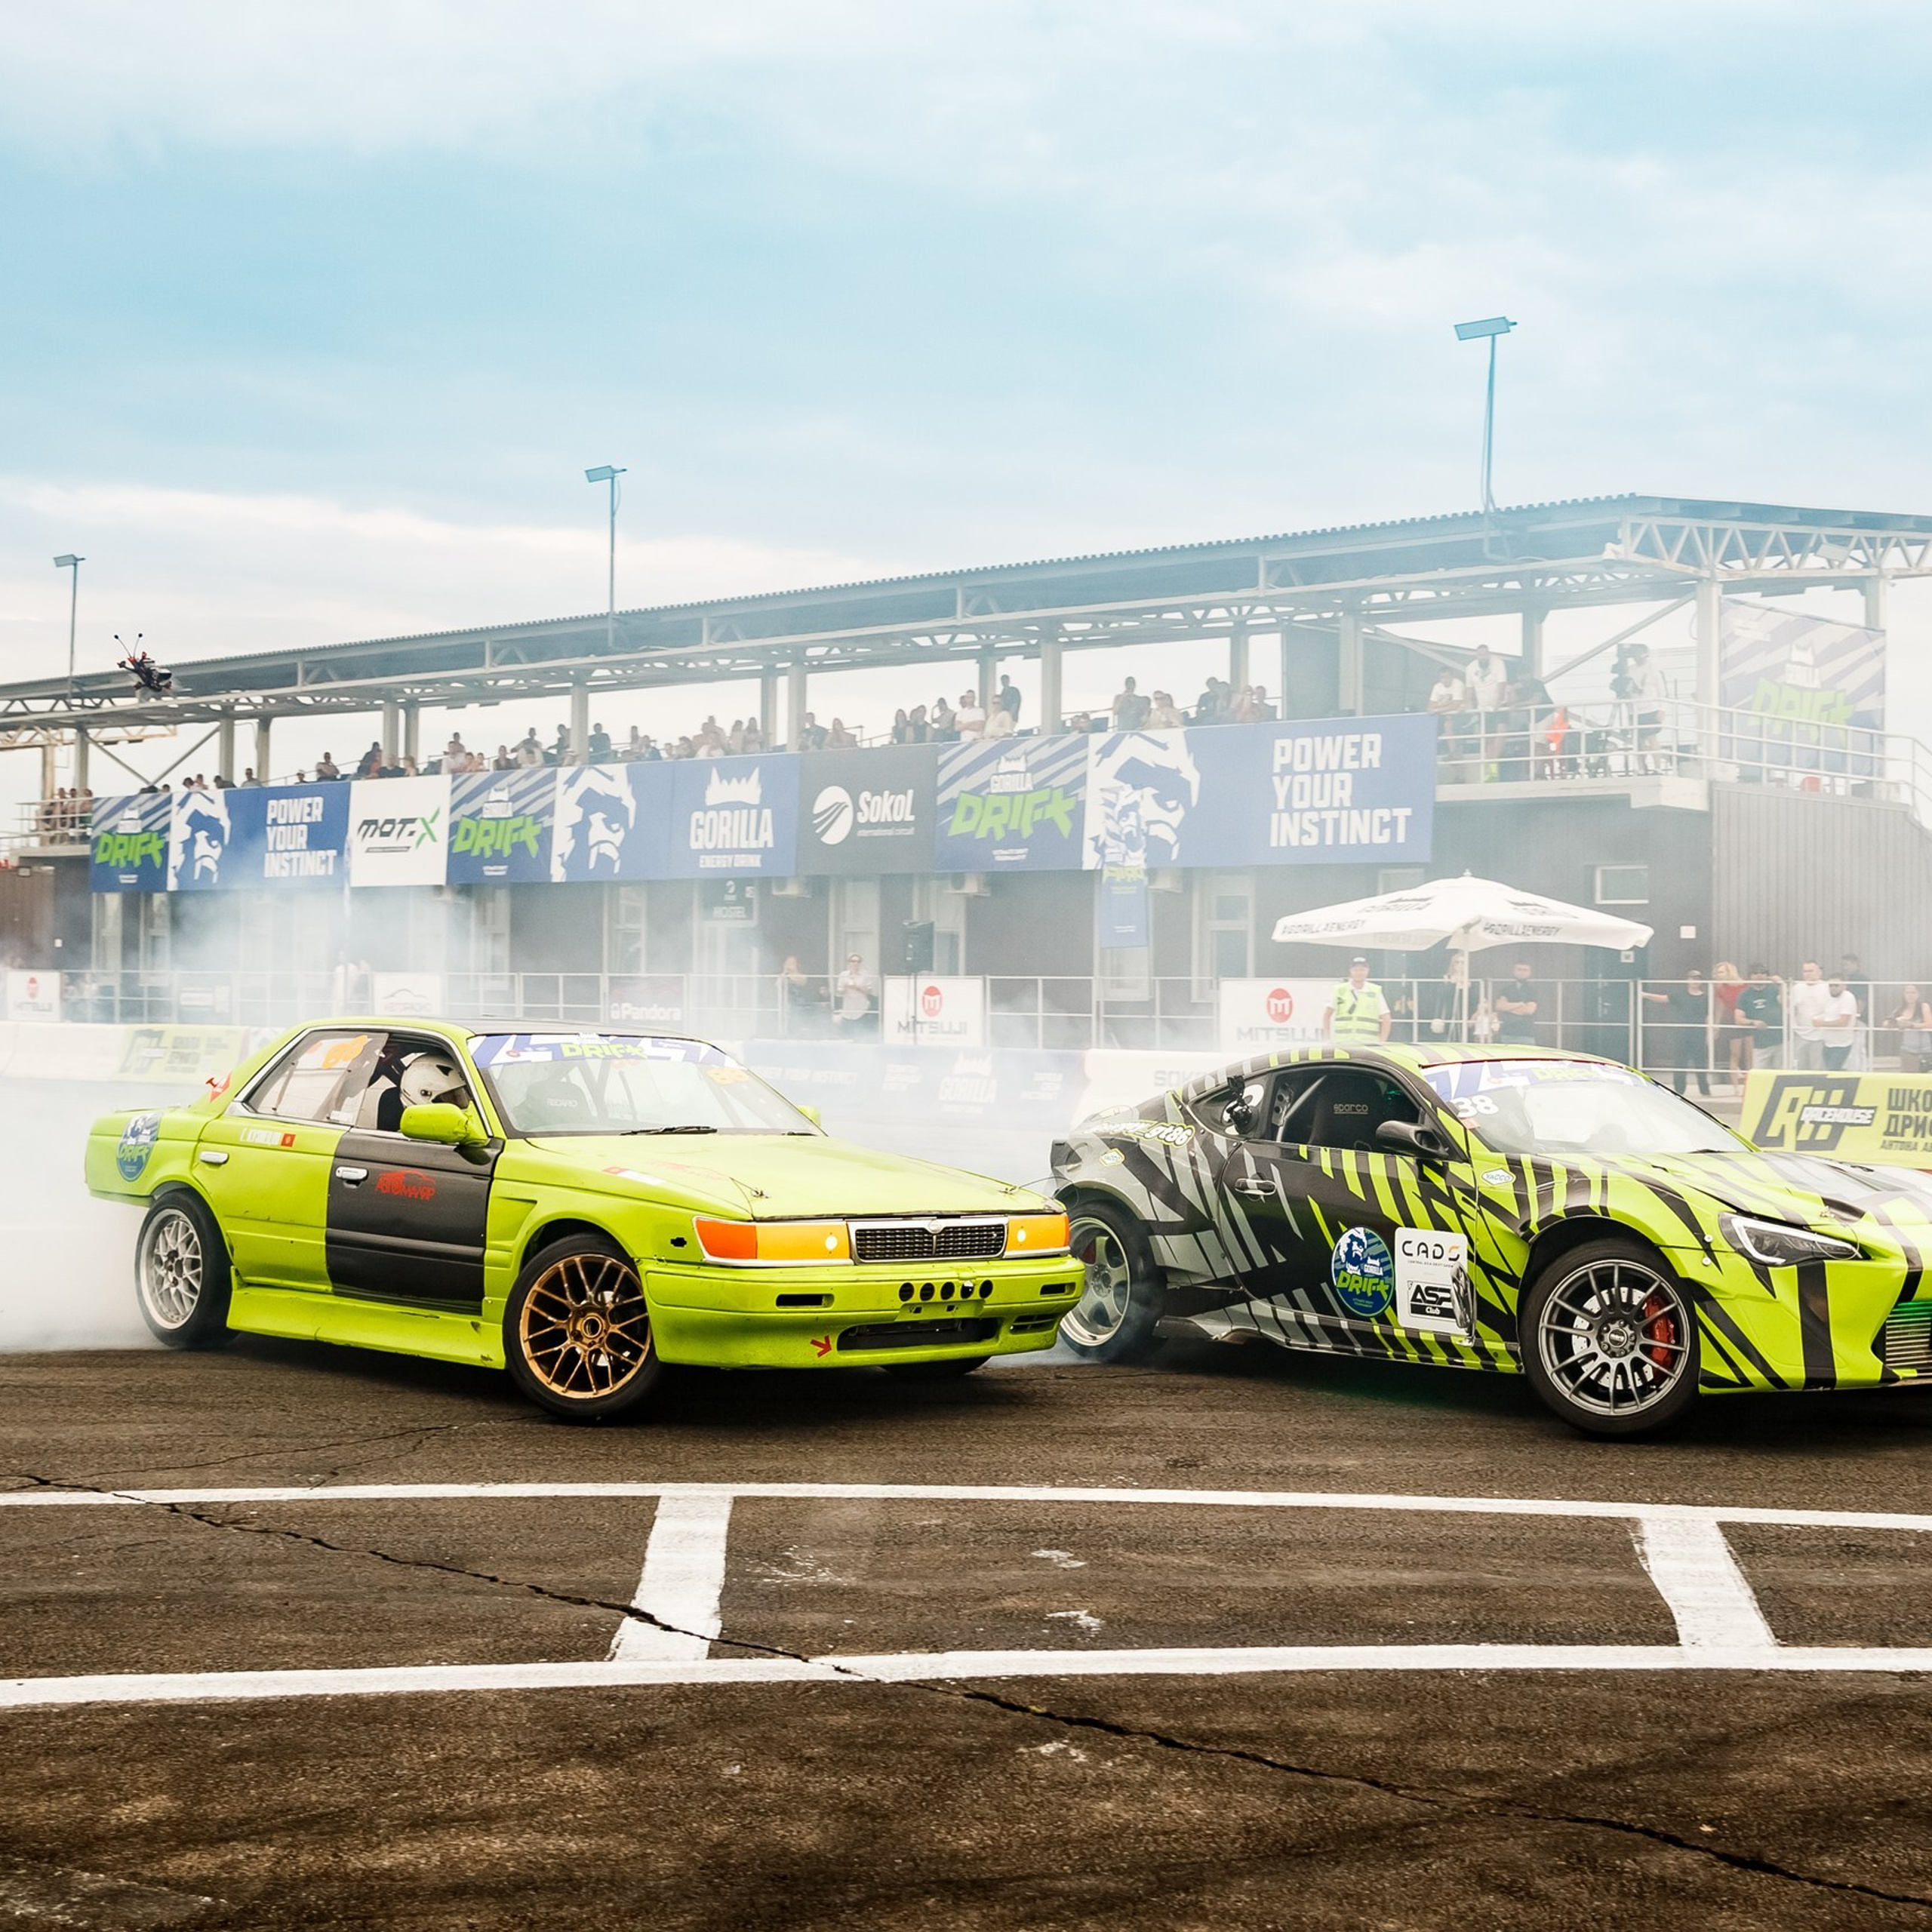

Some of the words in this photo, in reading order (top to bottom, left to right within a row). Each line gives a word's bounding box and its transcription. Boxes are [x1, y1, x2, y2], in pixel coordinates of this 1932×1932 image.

[1272, 733, 1382, 773] POWER
[1272, 772, 1353, 810] YOUR
[266, 796, 325, 825] POWER
[266, 824, 309, 851] YOUR
[689, 808, 774, 850] GORILLA
[1269, 808, 1413, 847] INSTINCT
[264, 850, 337, 878] INSTINCT
[621, 1004, 681, 1021] Pandora
[937, 1077, 998, 1103] GORILLA
[1333, 1103, 1369, 1115] sparco
[1449, 1094, 1499, 1118] 38
[1882, 1114, 1932, 1139] ДРИ
[1425, 1306, 1441, 1315] Club
